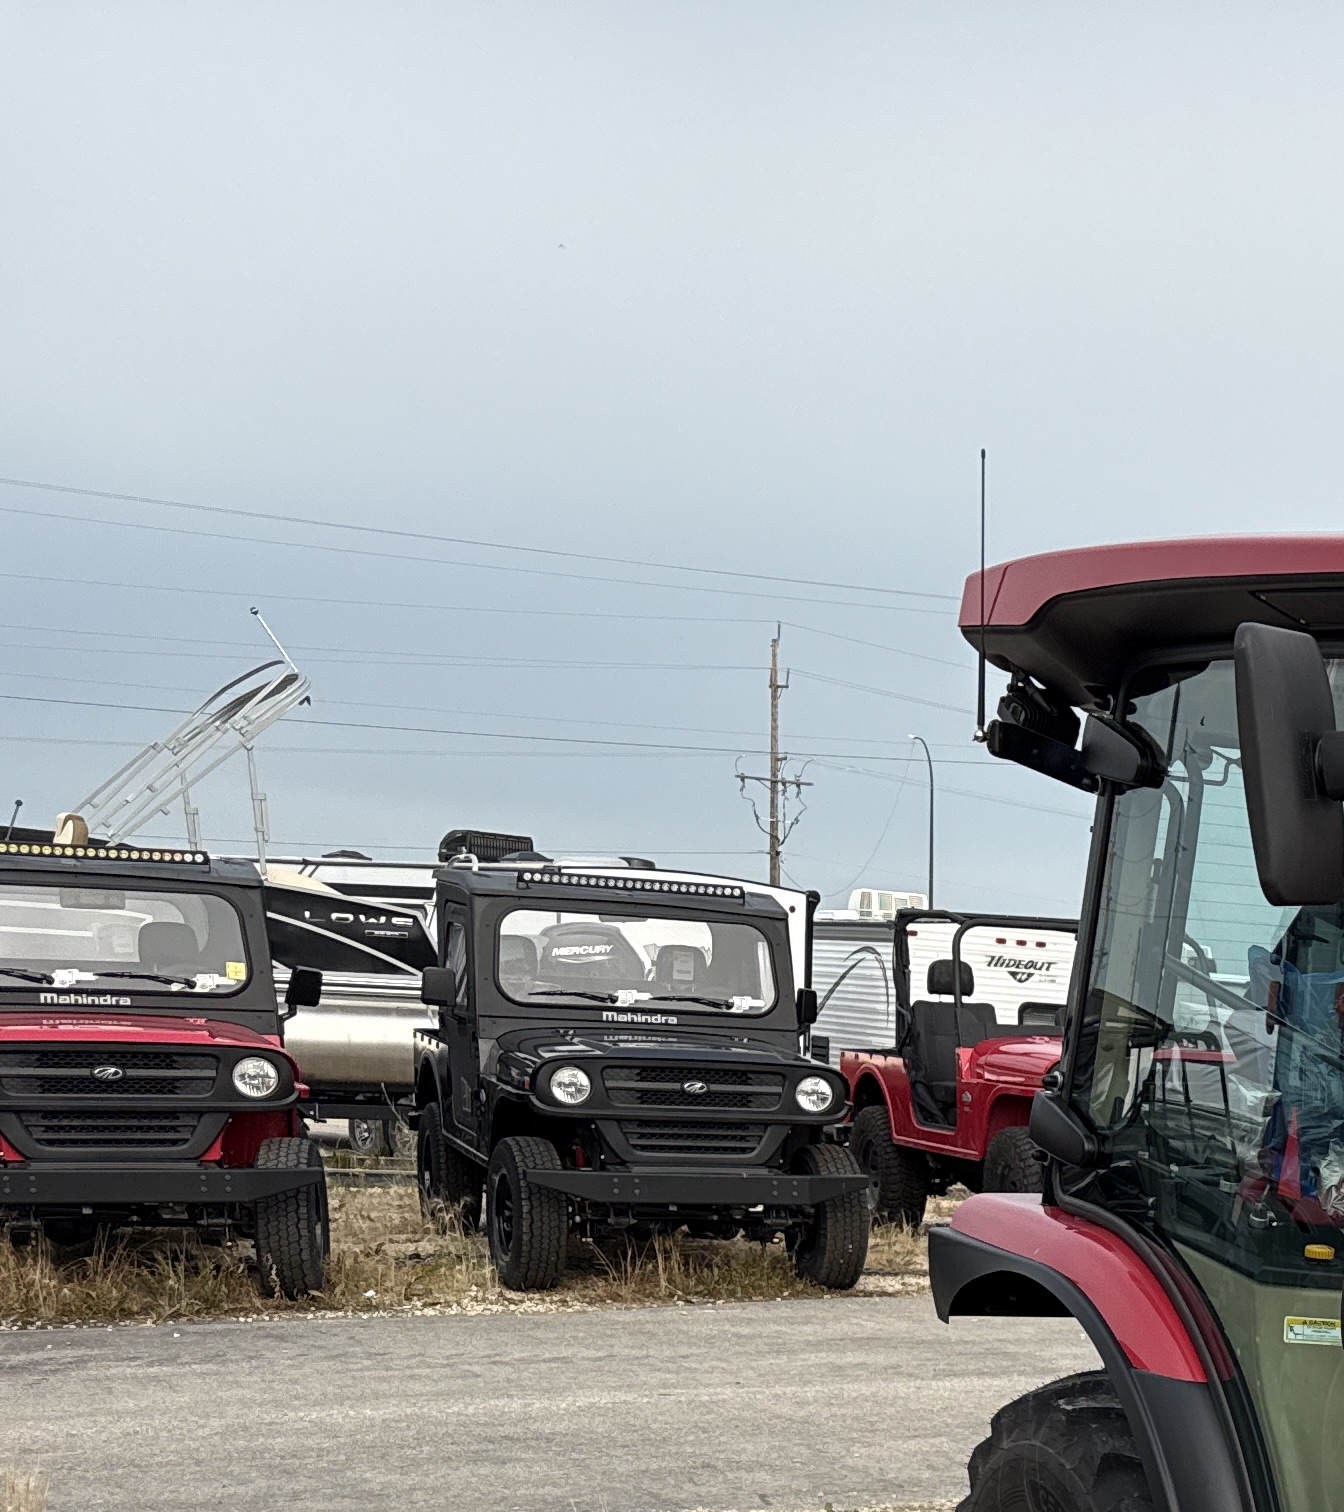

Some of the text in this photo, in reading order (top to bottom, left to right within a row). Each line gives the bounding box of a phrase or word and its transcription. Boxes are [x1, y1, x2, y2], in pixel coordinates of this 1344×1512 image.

[551, 944, 614, 957] MERCURY
[39, 992, 132, 1006] Mahindra
[602, 1010, 678, 1025] Mahindra
